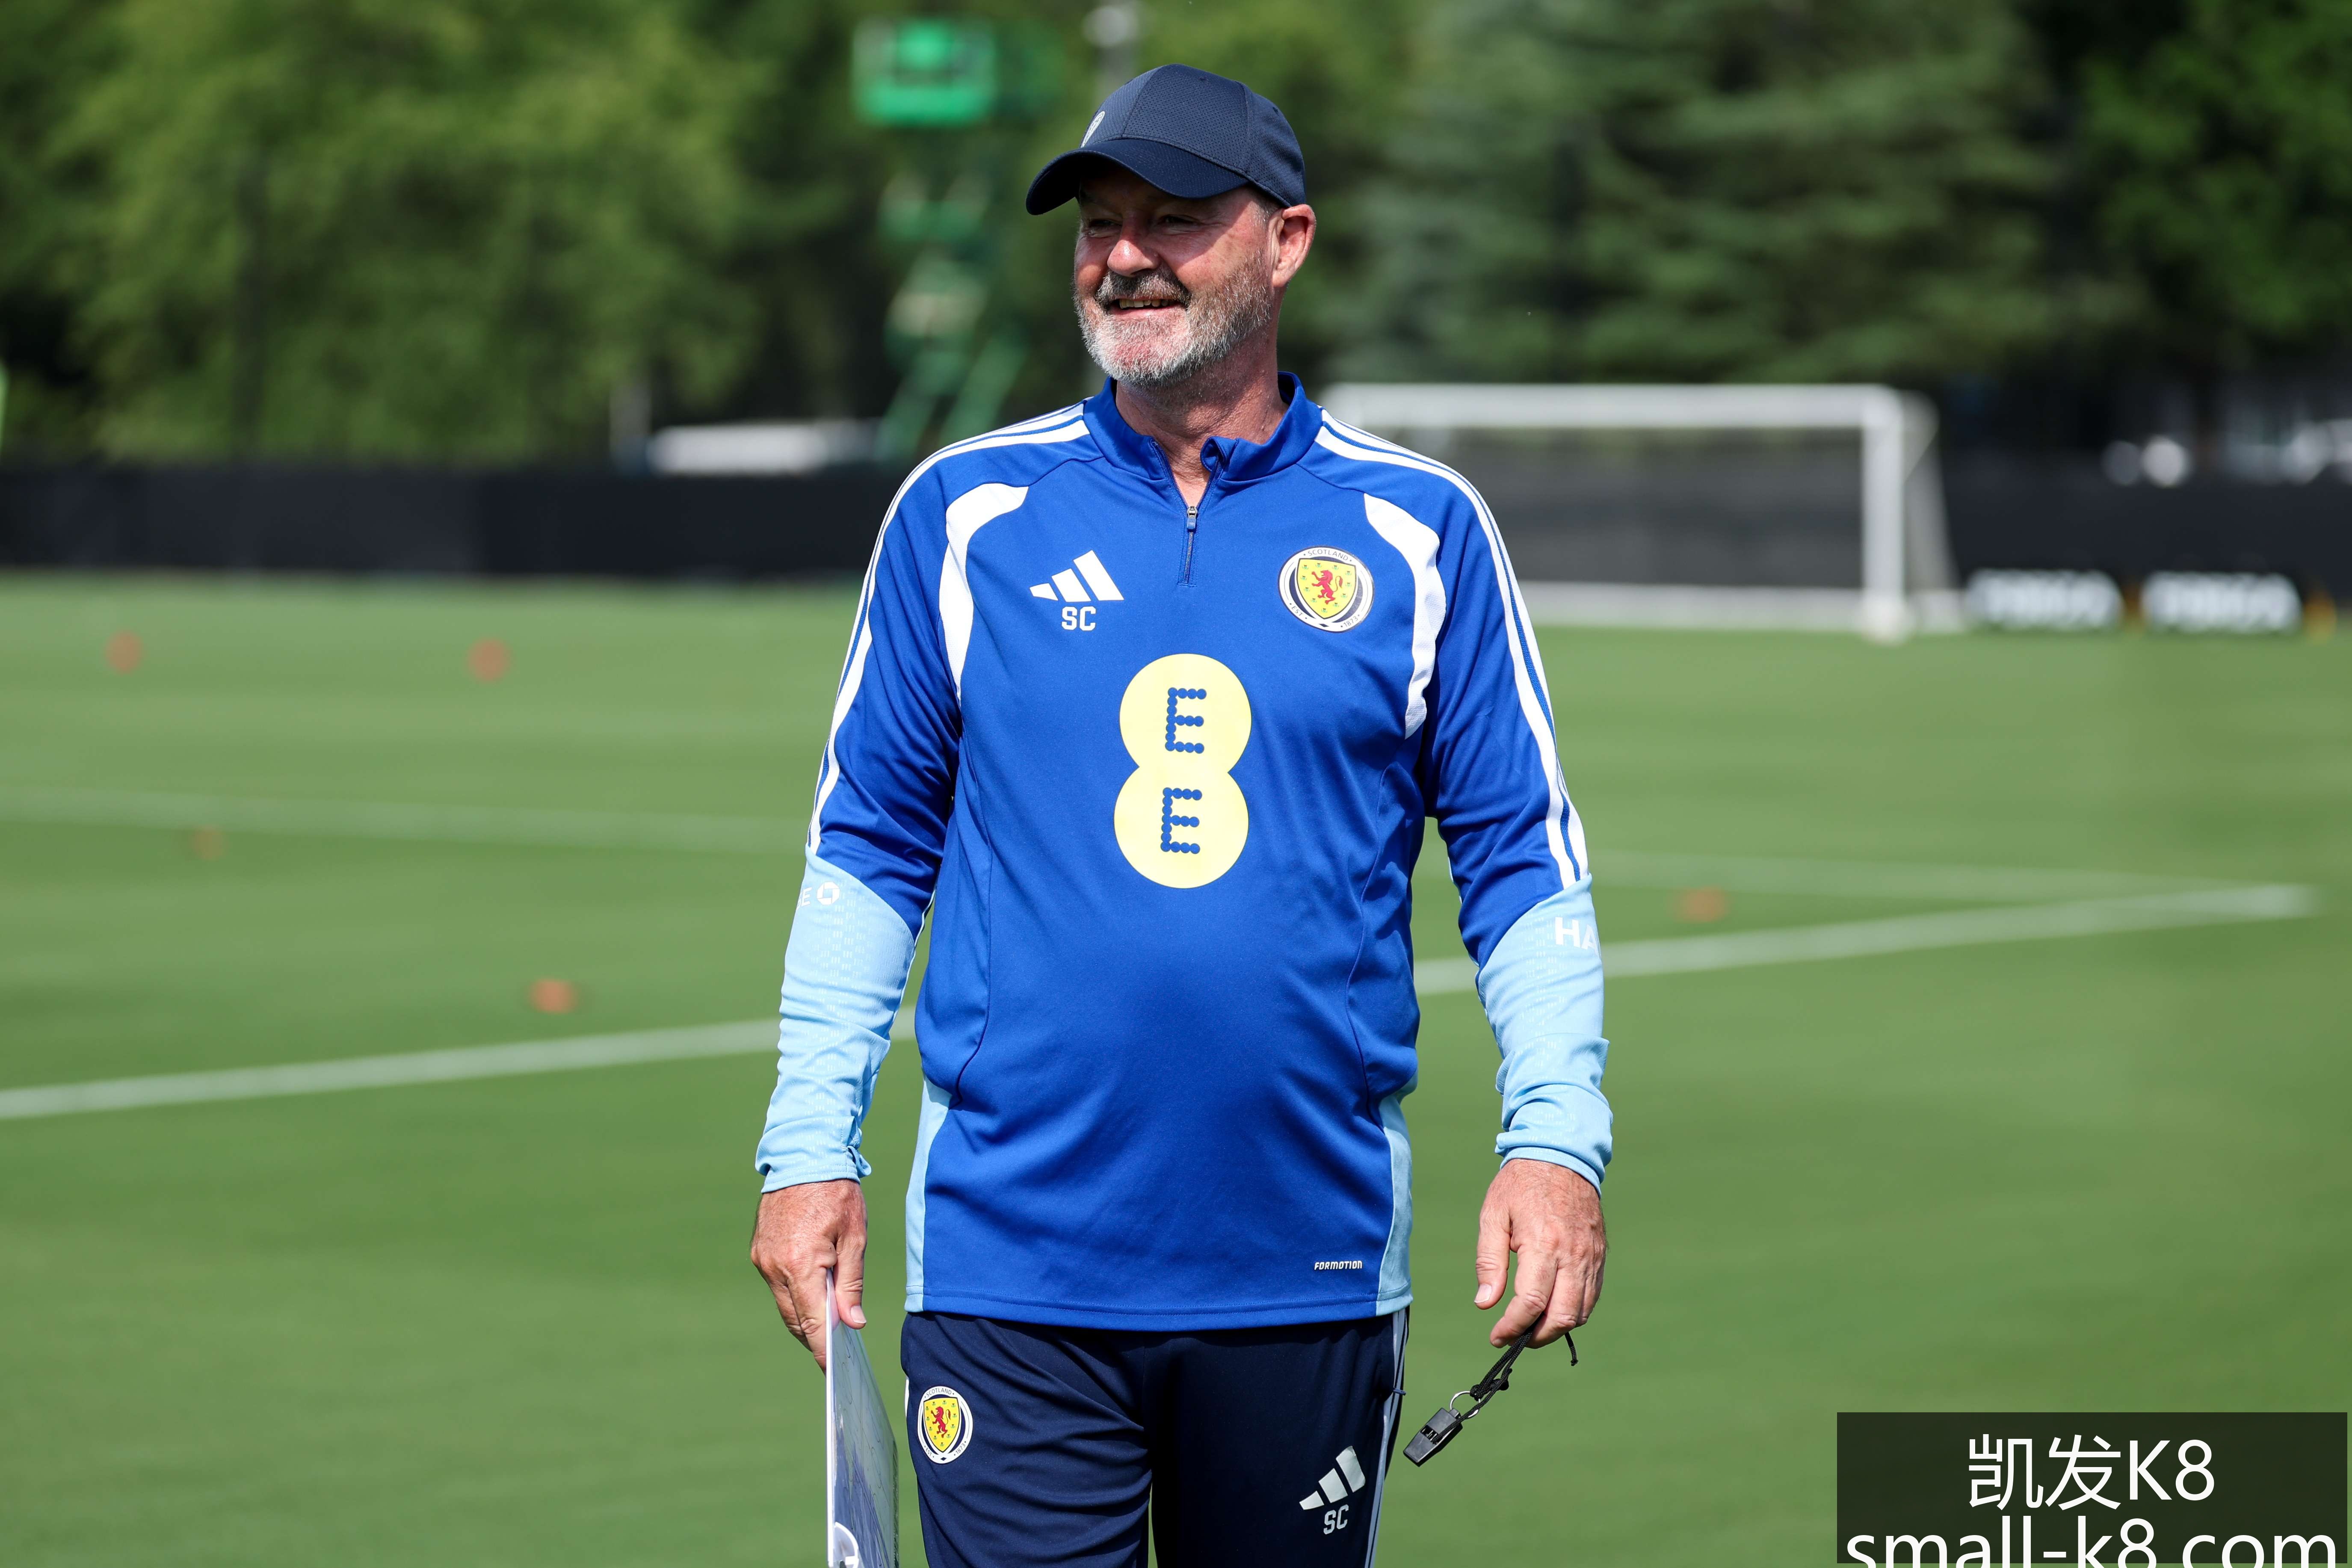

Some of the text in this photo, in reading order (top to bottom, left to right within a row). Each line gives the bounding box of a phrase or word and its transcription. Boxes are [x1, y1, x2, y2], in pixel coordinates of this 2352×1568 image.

[1308, 549, 1348, 561] SCOTLAND
[1062, 606, 1096, 631] SC
[1292, 606, 1358, 627] EST 1873
[1314, 1260, 1362, 1270] FORMOTION
[926, 1388, 952, 1397] SCOTLAND
[956, 1443, 965, 1454] 1873
[1323, 1504, 1349, 1535] SC
